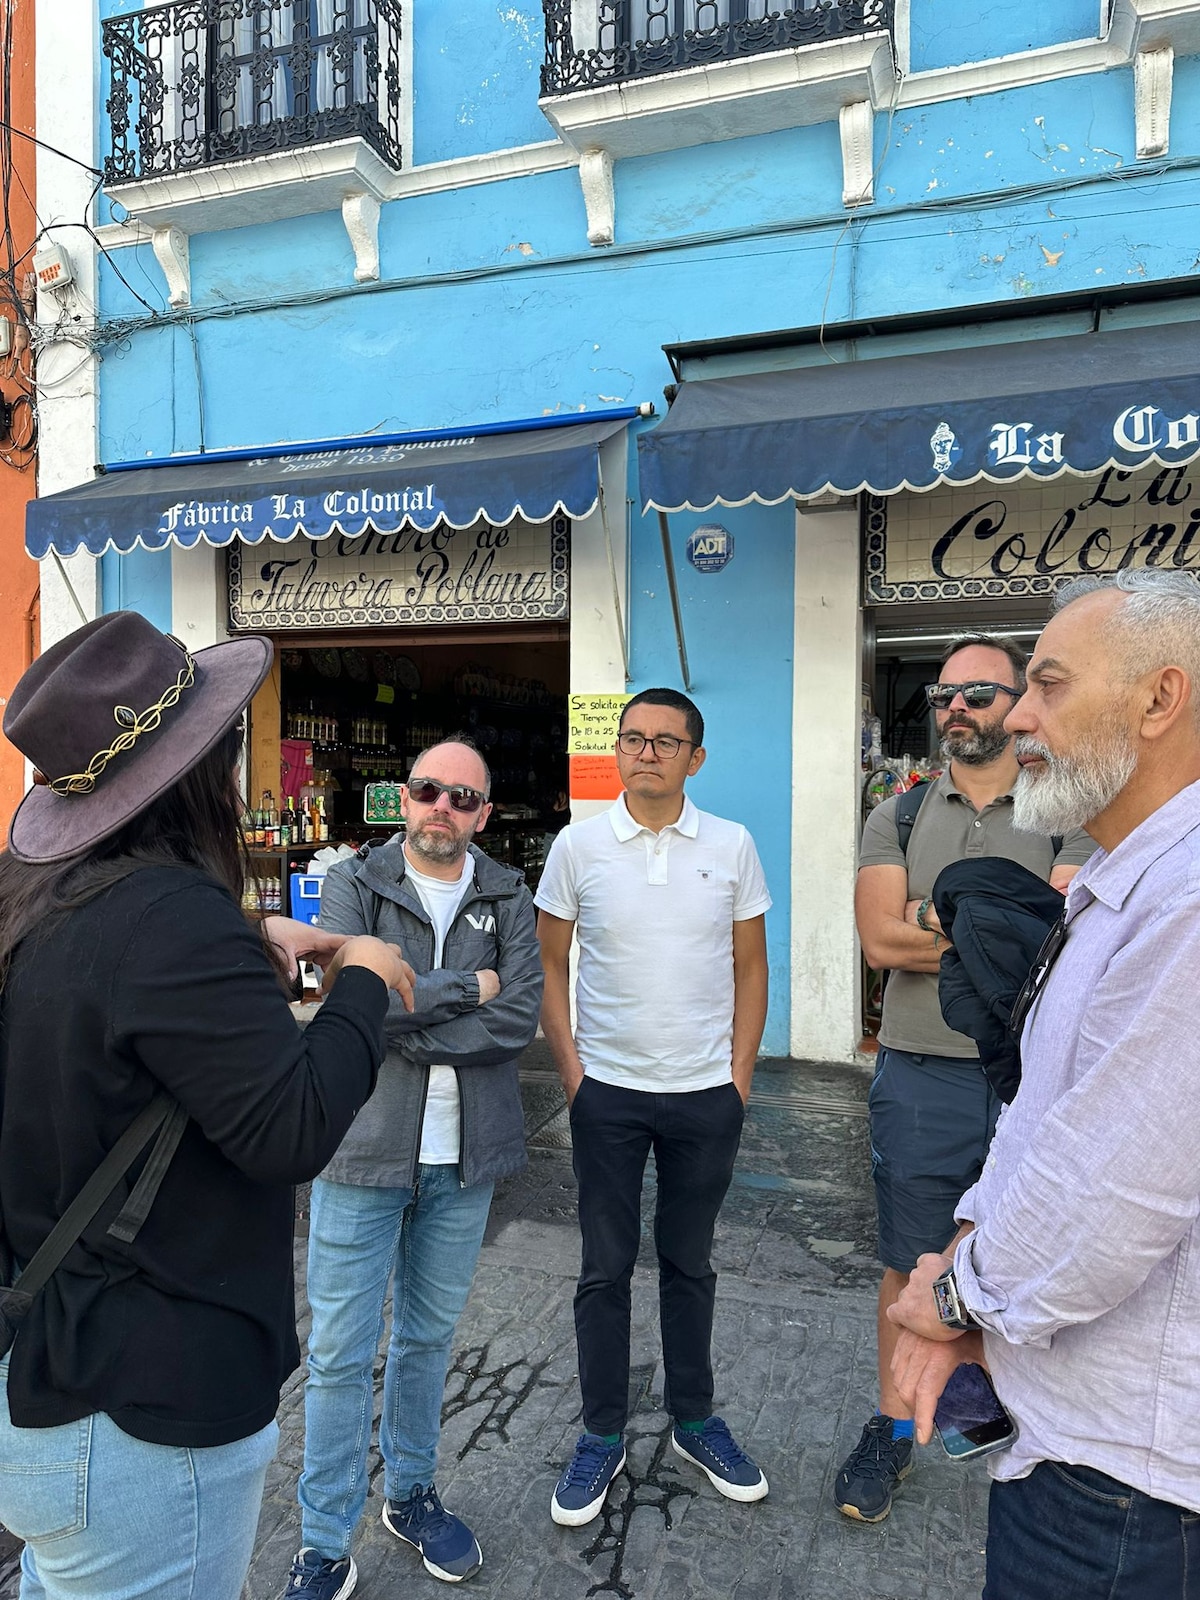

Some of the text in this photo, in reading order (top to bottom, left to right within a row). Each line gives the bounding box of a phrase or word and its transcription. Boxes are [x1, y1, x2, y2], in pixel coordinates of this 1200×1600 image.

[990, 422, 1066, 466] La
[347, 453, 406, 466] 1959
[158, 484, 435, 533] Fábrica La Colonial
[476, 522, 510, 549] de
[693, 537, 726, 556] ADT
[250, 548, 547, 612] Talavera Poblana
[571, 695, 586, 710] Se
[590, 698, 618, 710] solicita
[580, 713, 608, 723] Tiempo
[571, 726, 582, 736] De
[584, 727, 593, 736] 18
[603, 727, 614, 735] 25
[575, 741, 607, 750] Solicitud
